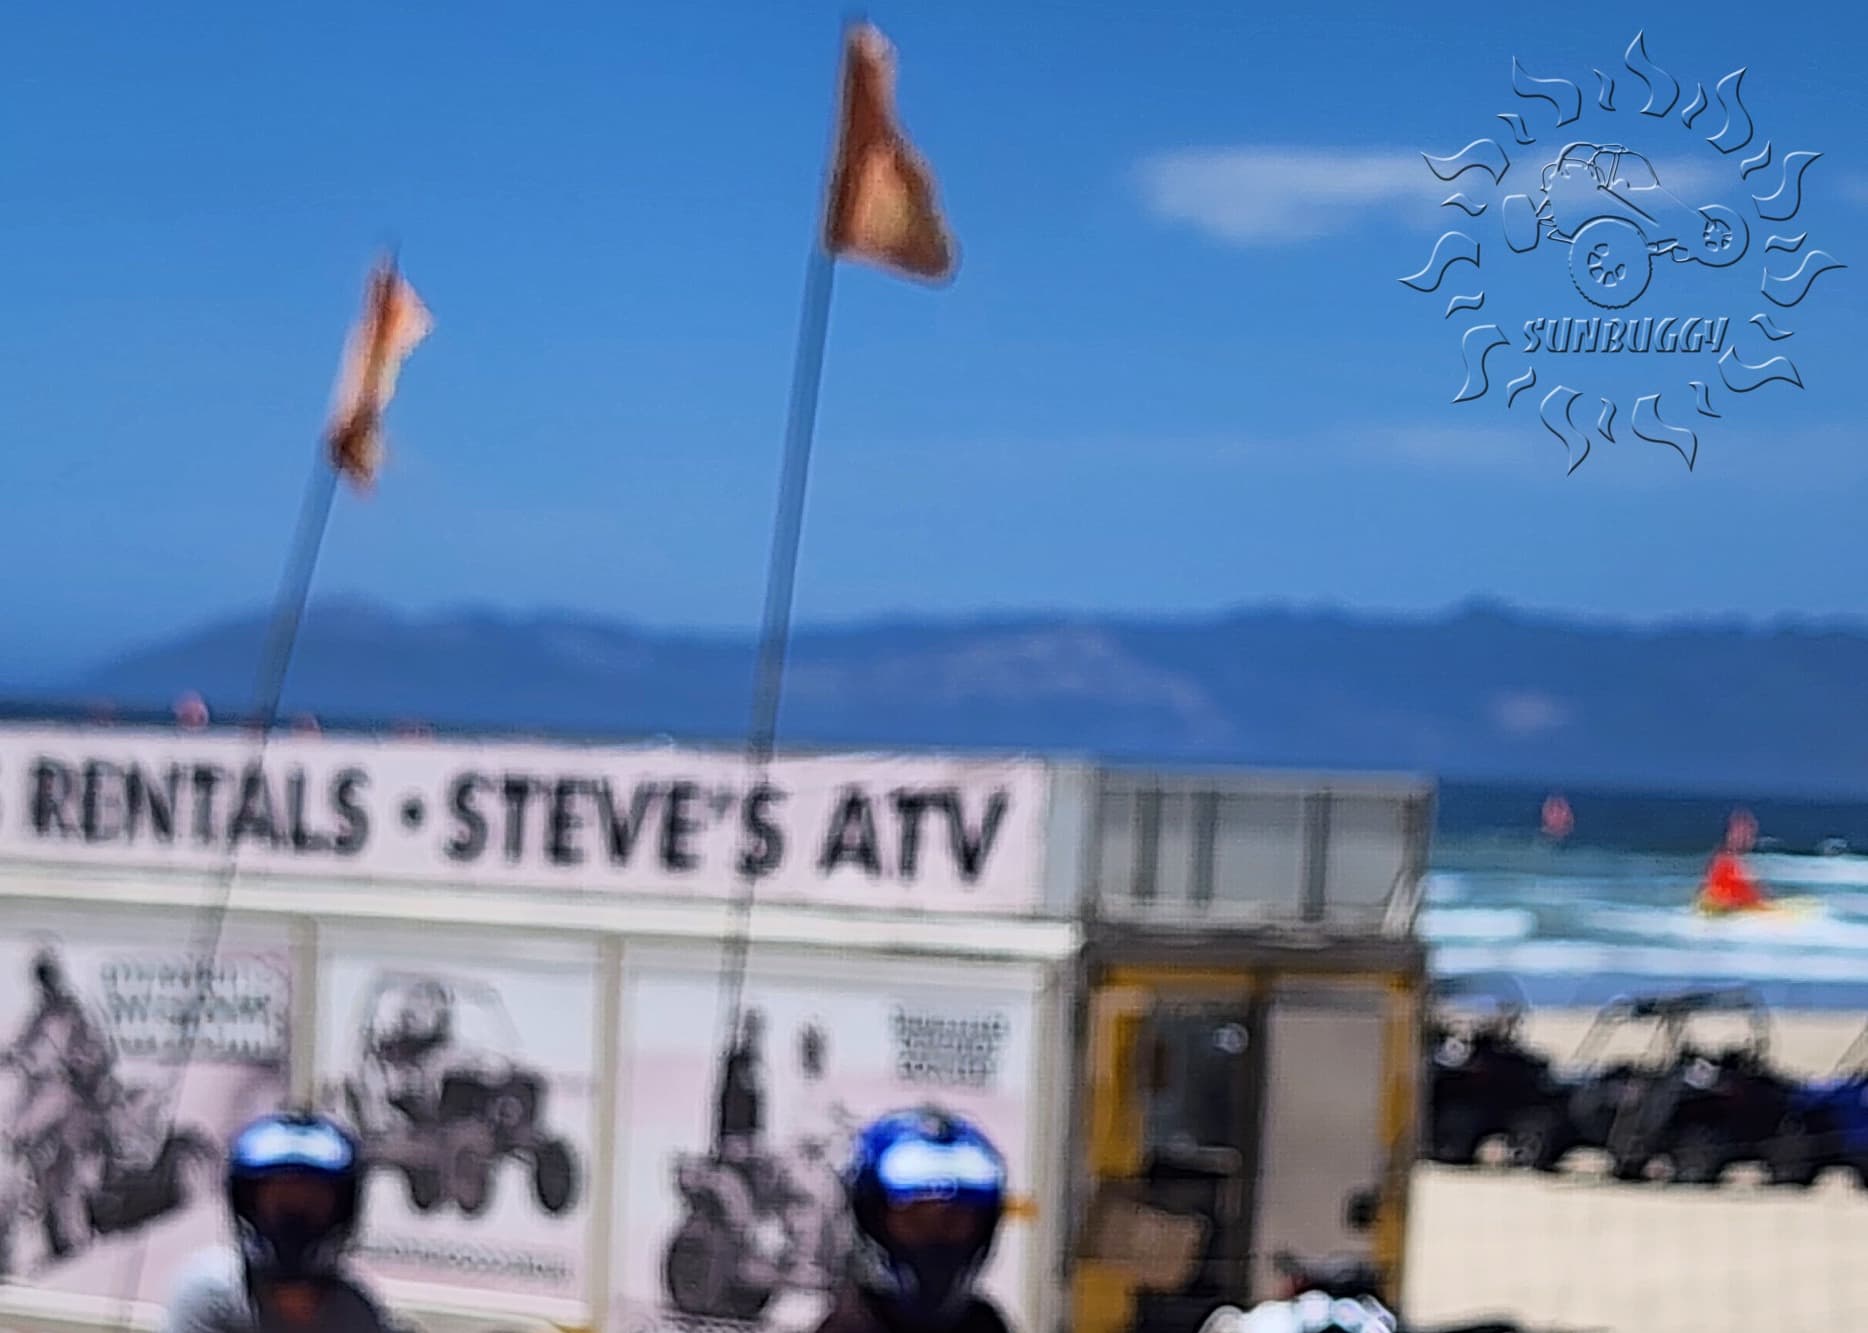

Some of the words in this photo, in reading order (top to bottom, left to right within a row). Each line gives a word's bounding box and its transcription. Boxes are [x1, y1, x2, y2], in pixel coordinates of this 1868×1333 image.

[30, 756, 370, 855] RENTALS
[445, 771, 789, 878] STEVE'S
[817, 783, 1008, 882] ATV
